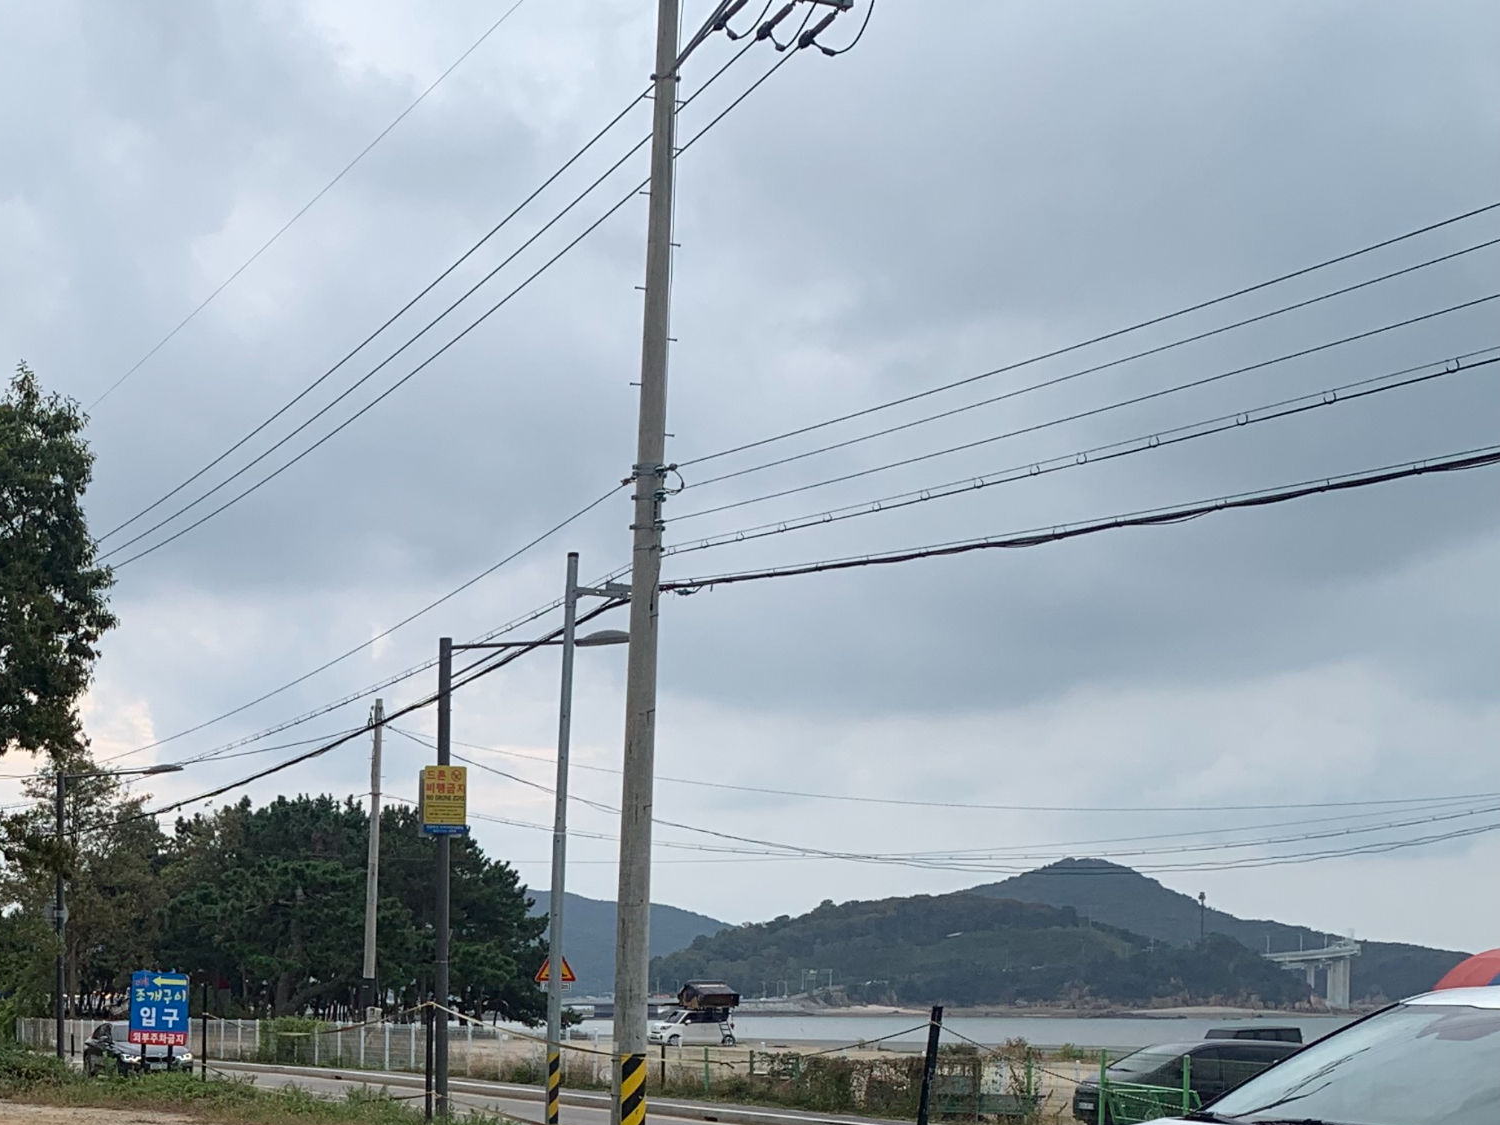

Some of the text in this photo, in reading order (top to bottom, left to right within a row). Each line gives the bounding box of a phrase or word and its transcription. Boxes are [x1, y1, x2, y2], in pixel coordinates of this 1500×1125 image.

[426, 770, 447, 781] 드론
[426, 782, 465, 794] 비행금지
[135, 988, 187, 1004] 조개구이
[140, 1006, 180, 1028] 입구
[133, 1032, 184, 1044] 외부주차금지
